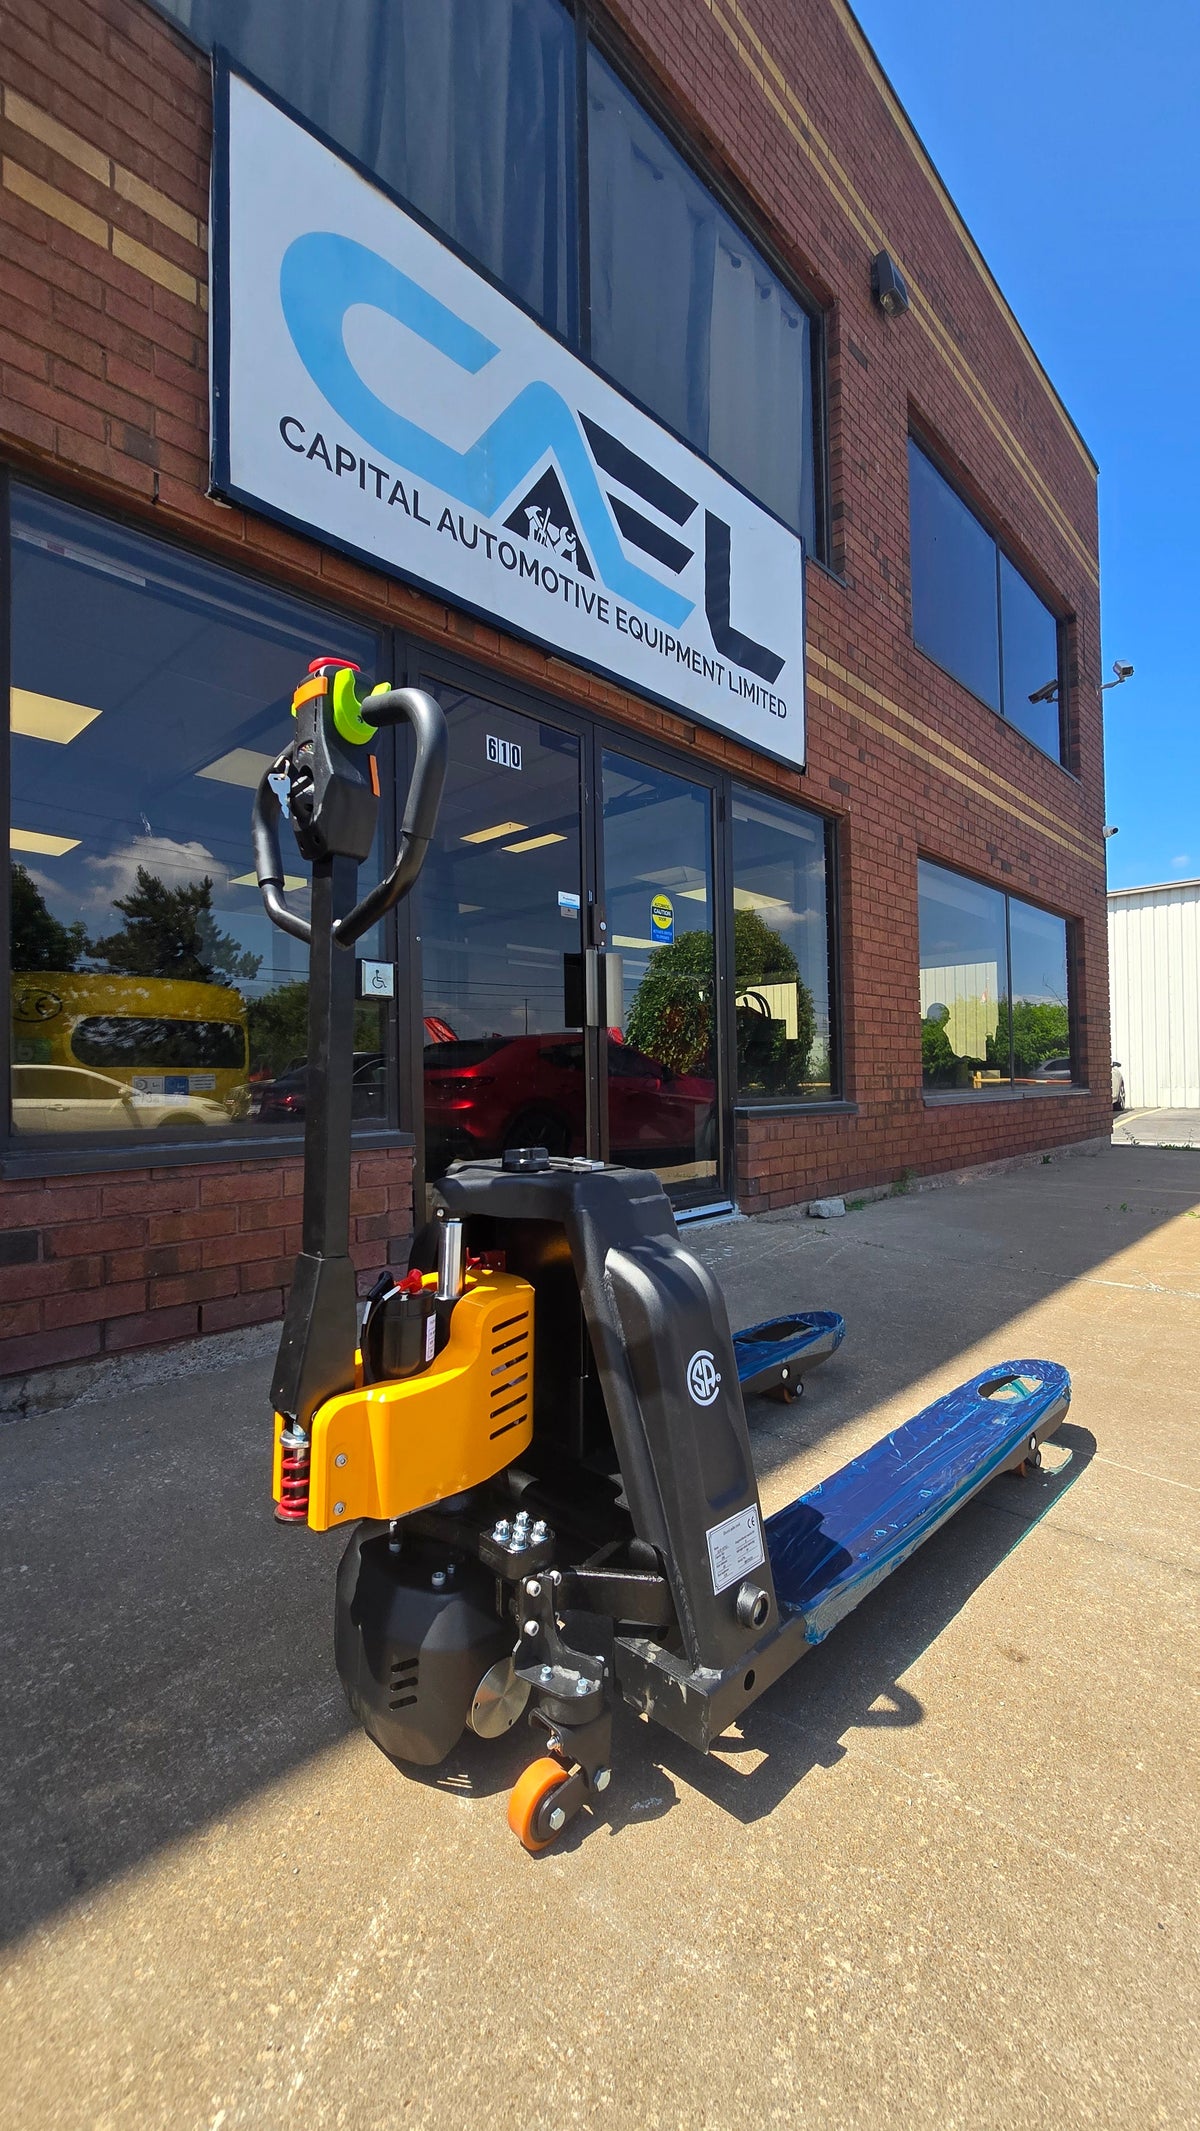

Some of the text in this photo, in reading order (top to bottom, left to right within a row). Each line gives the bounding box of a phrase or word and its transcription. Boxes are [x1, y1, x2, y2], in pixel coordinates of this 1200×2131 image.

[279, 416, 787, 719] CAPITAL AUTOMOTIVE EQUIPMENT LIMITED
[488, 737, 520, 767] 610
[653, 908, 672, 916] CAUTION
